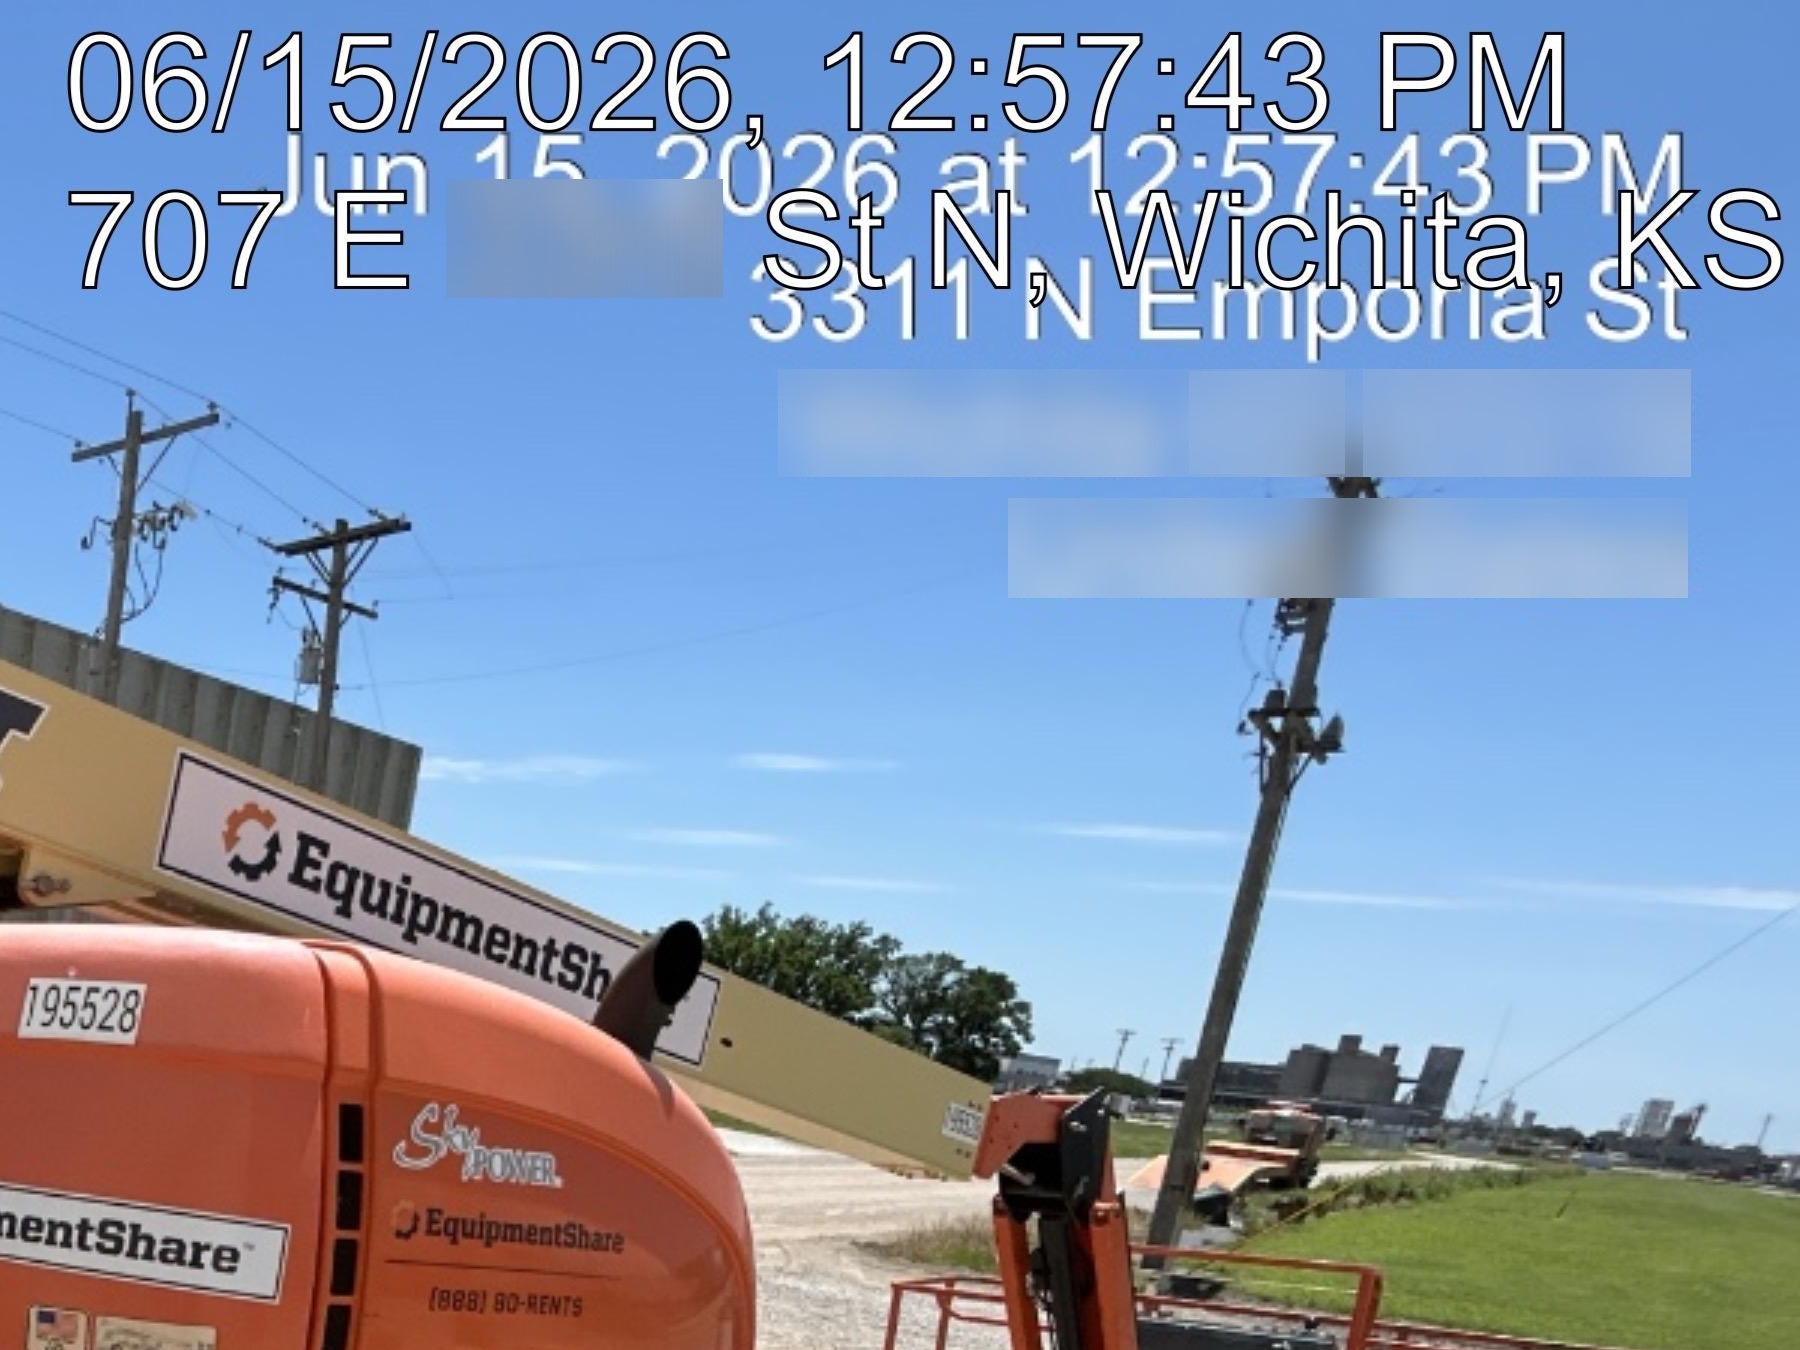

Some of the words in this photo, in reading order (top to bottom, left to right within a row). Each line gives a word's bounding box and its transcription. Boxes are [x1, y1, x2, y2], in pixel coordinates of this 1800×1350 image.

[287, 831, 611, 1002] EquipmentSh
[26, 983, 141, 1034] 195528
[425, 1208, 625, 1253] EquipmentShare
